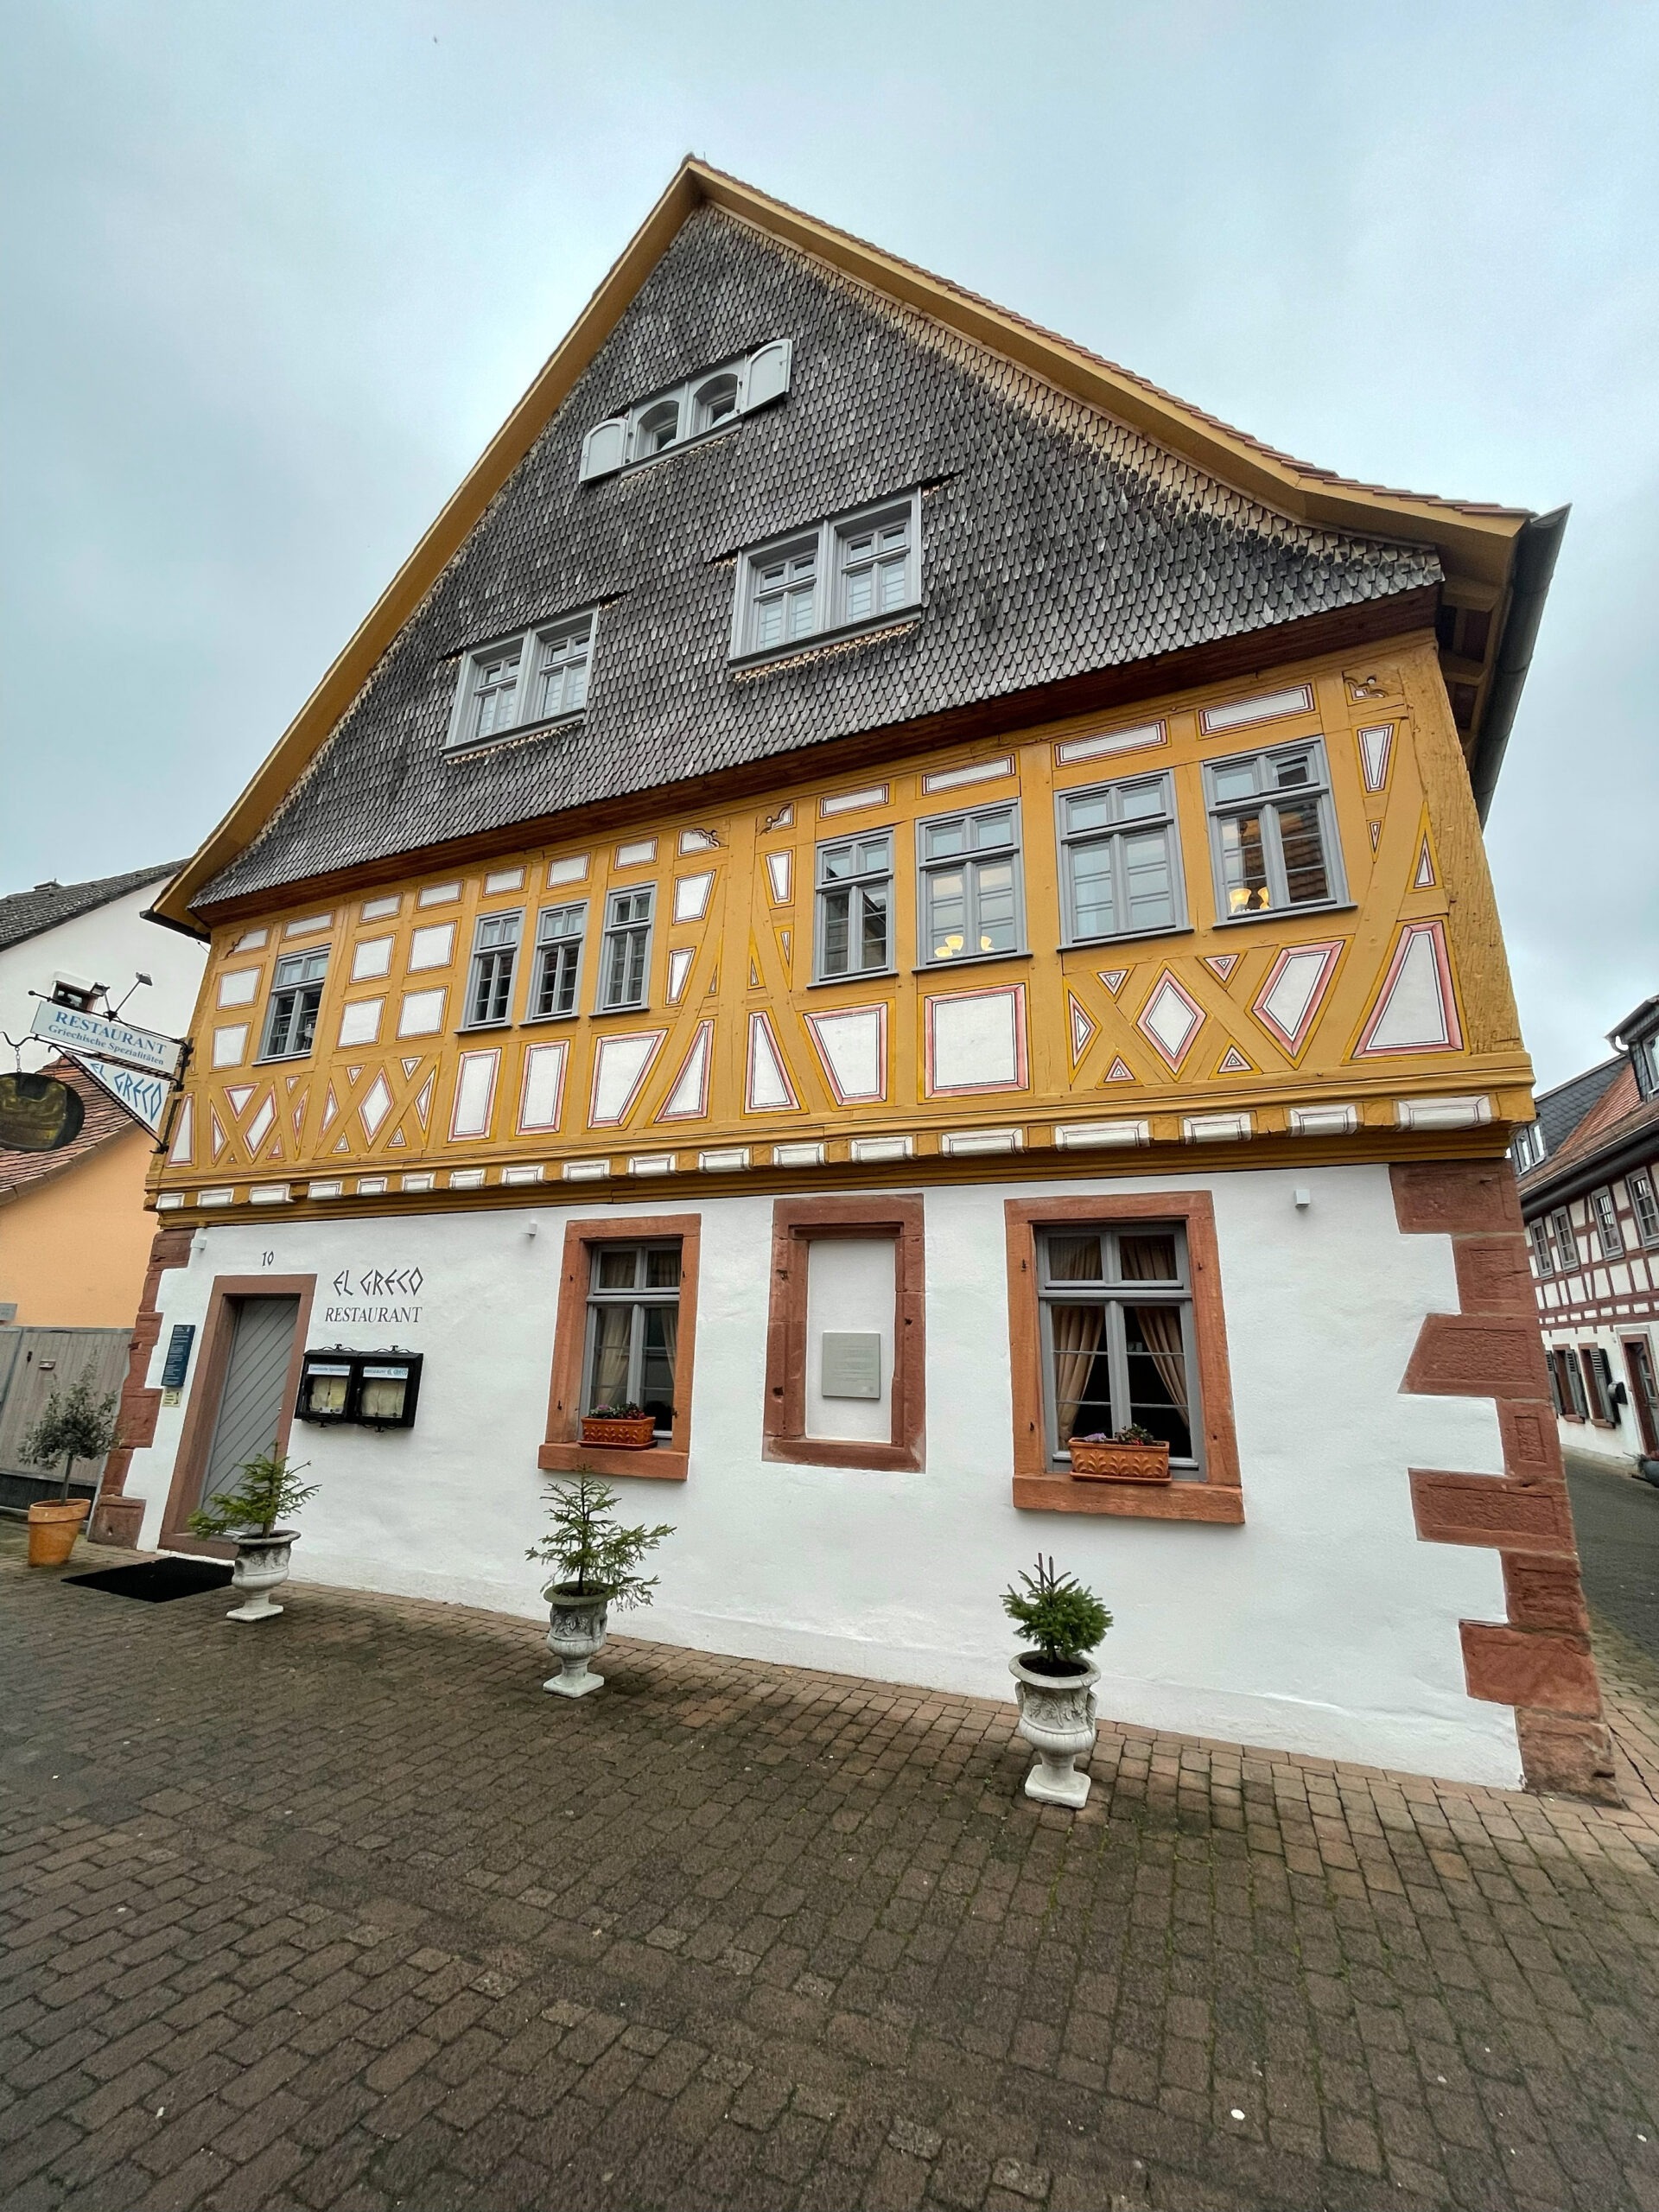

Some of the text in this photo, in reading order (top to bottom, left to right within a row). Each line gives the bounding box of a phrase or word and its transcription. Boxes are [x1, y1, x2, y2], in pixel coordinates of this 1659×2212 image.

[48, 1025, 164, 1065] Griechische Spezialitäten
[55, 1011, 167, 1054] RESTAURANT
[90, 1063, 162, 1122] EL GRECO
[262, 1251, 274, 1267] 10
[333, 1267, 423, 1296] EL GRECO
[325, 1306, 423, 1323] RESTAURANT
